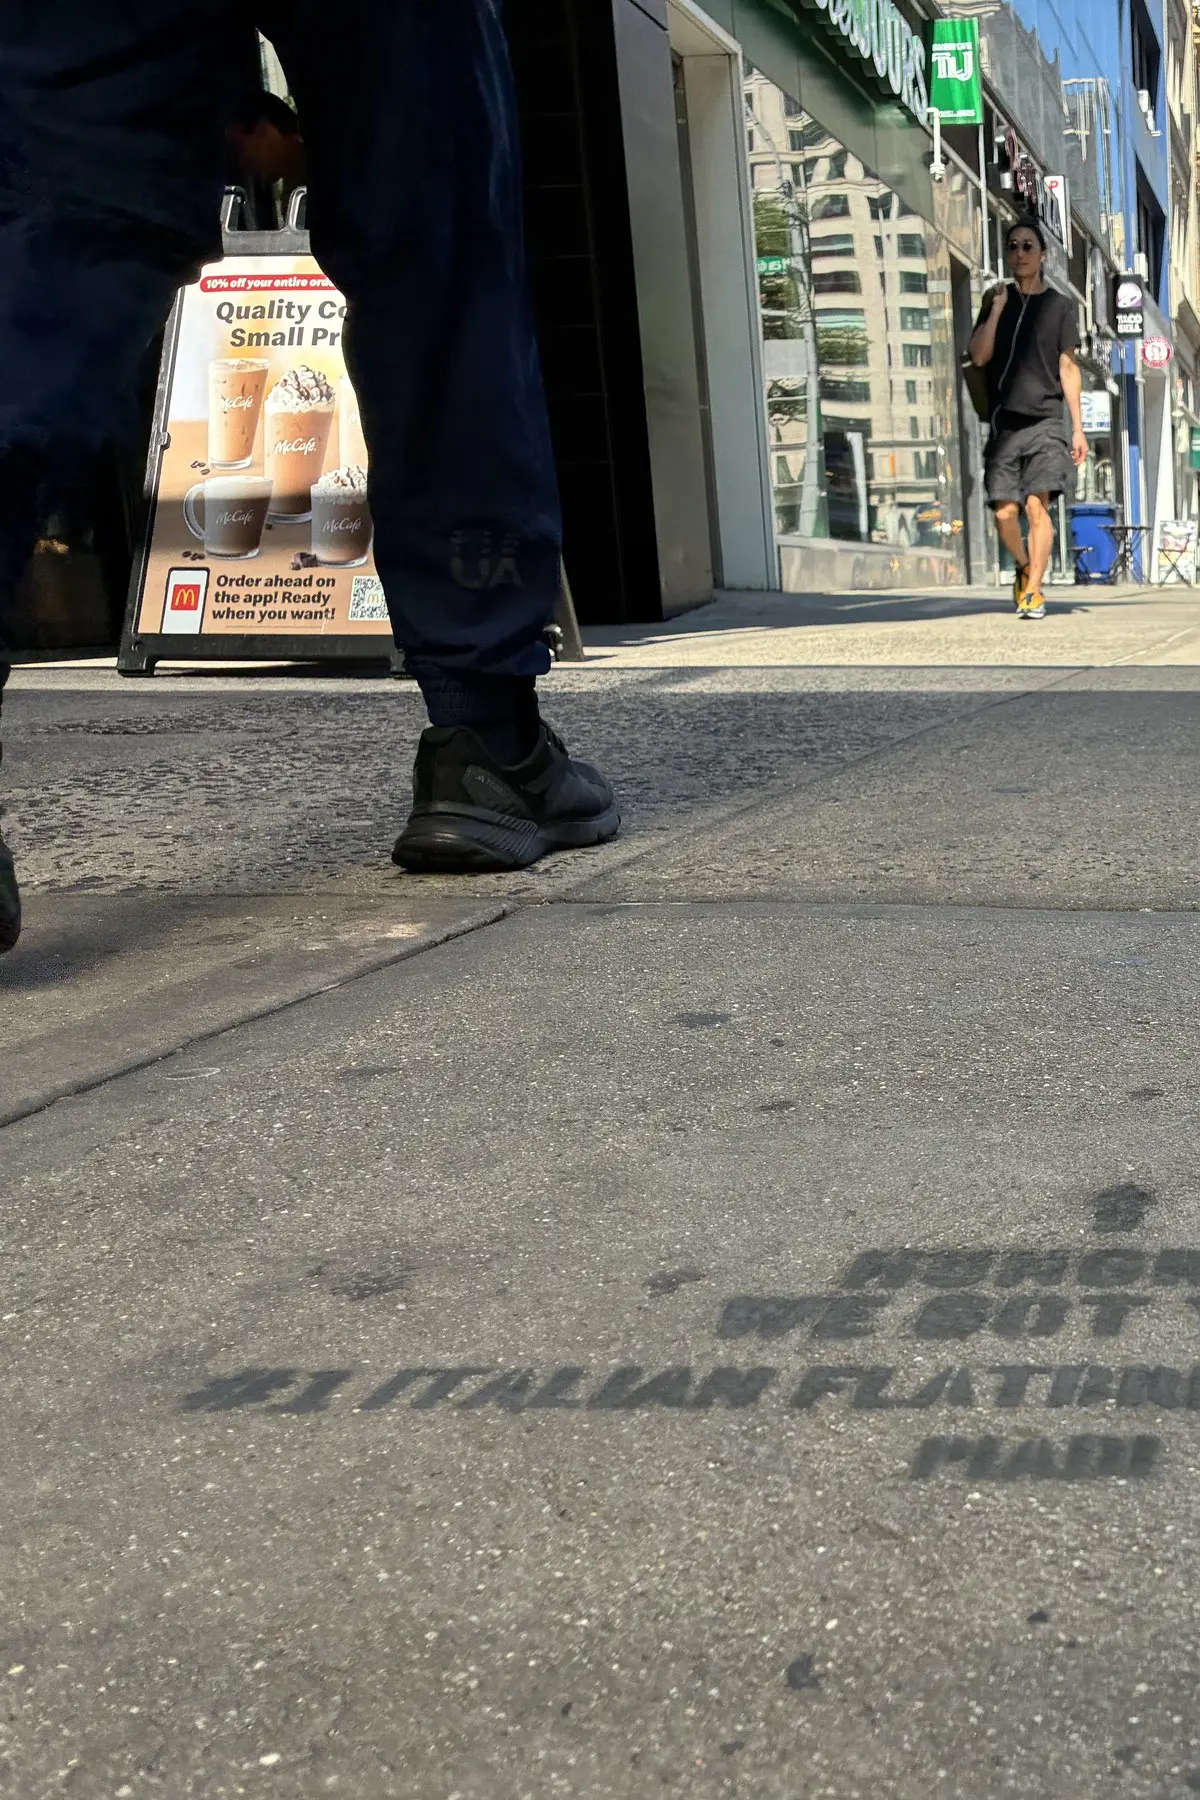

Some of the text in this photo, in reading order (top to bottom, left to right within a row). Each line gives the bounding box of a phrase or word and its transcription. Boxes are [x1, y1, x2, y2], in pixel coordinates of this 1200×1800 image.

[206, 278, 229, 289] 10%
[230, 276, 248, 288] off
[247, 278, 274, 290] your
[274, 276, 307, 288] entire
[216, 298, 312, 325] Quality
[1116, 313, 1143, 324] TACO
[230, 327, 340, 347] Small Pr
[217, 574, 336, 588] Order ahead on
[214, 591, 331, 607] the app! Ready
[212, 607, 336, 623] when you want!
[721, 1296, 890, 1338] WE
[916, 1295, 1150, 1338] GOT
[183, 1367, 353, 1412] #1
[358, 1366, 778, 1411] ITALIAN
